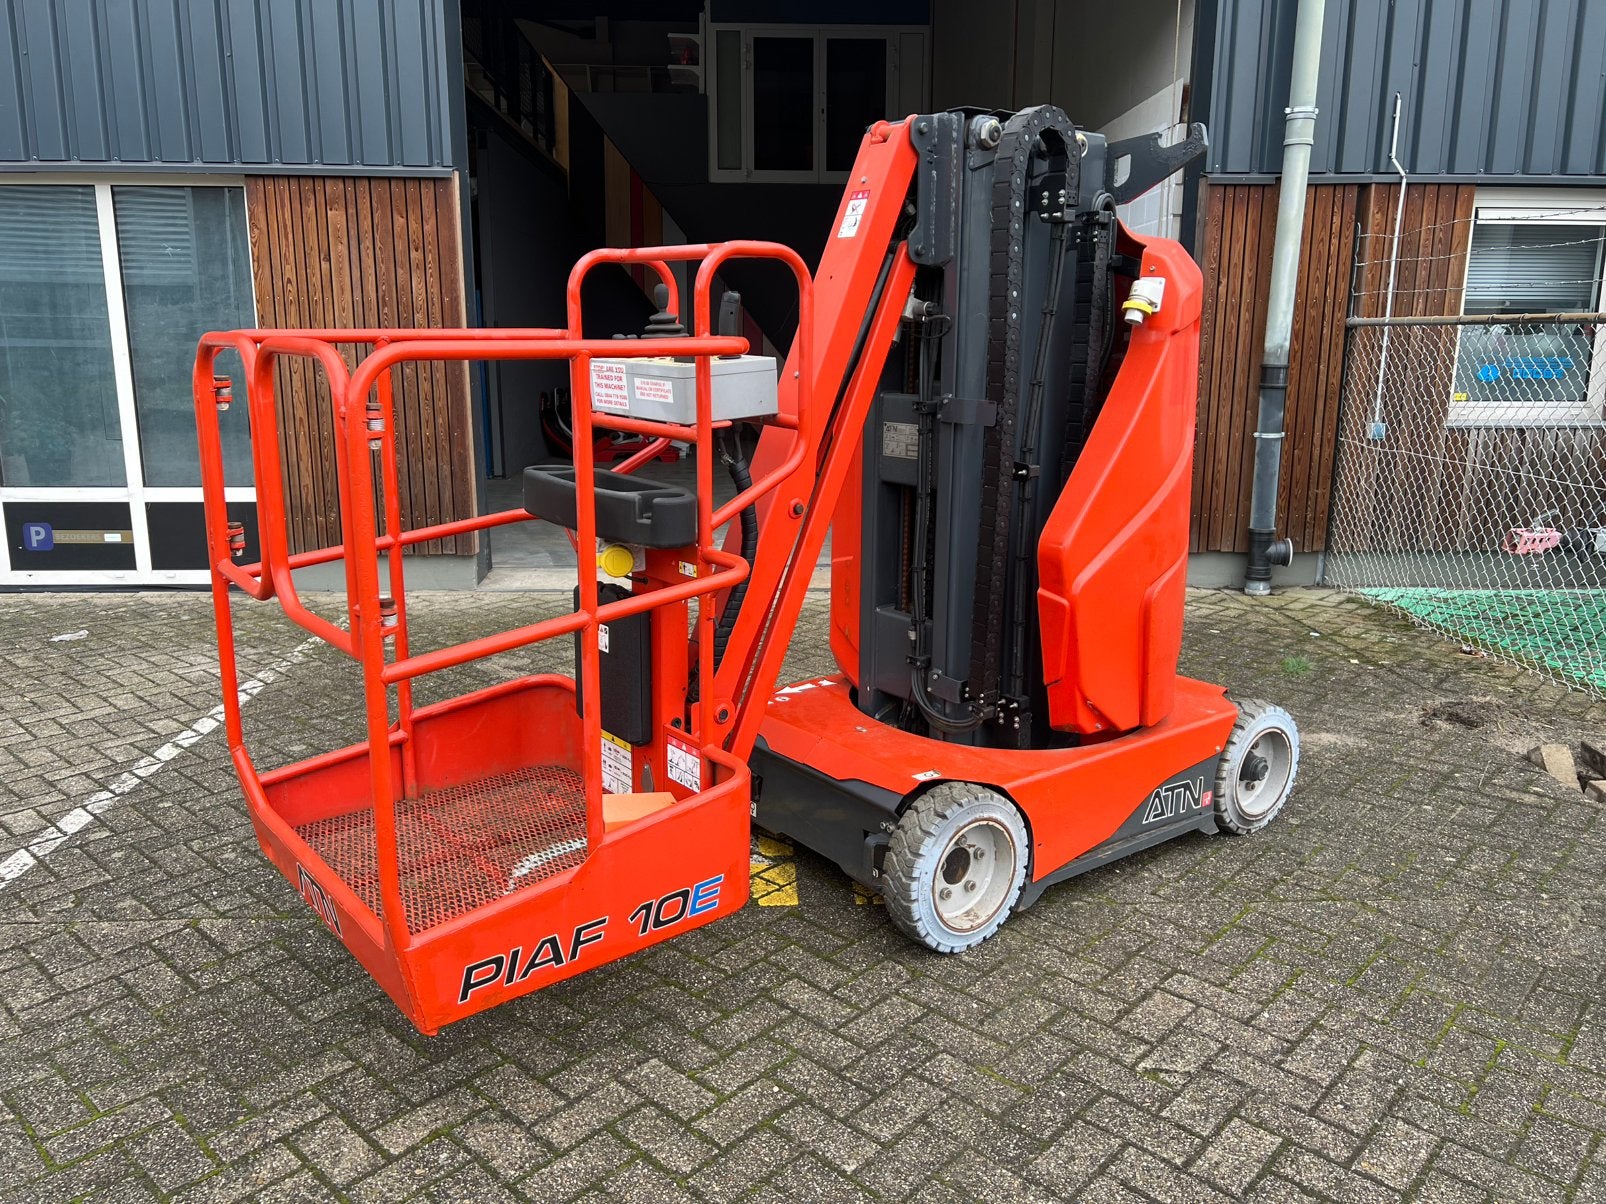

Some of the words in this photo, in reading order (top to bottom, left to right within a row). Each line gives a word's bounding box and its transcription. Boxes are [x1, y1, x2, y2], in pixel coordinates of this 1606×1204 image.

[595, 373, 613, 381] TRAINED
[30, 526, 46, 547] P
[1142, 776, 1204, 825] ATN
[458, 916, 609, 1004] PIAF
[628, 874, 725, 937] 10E
